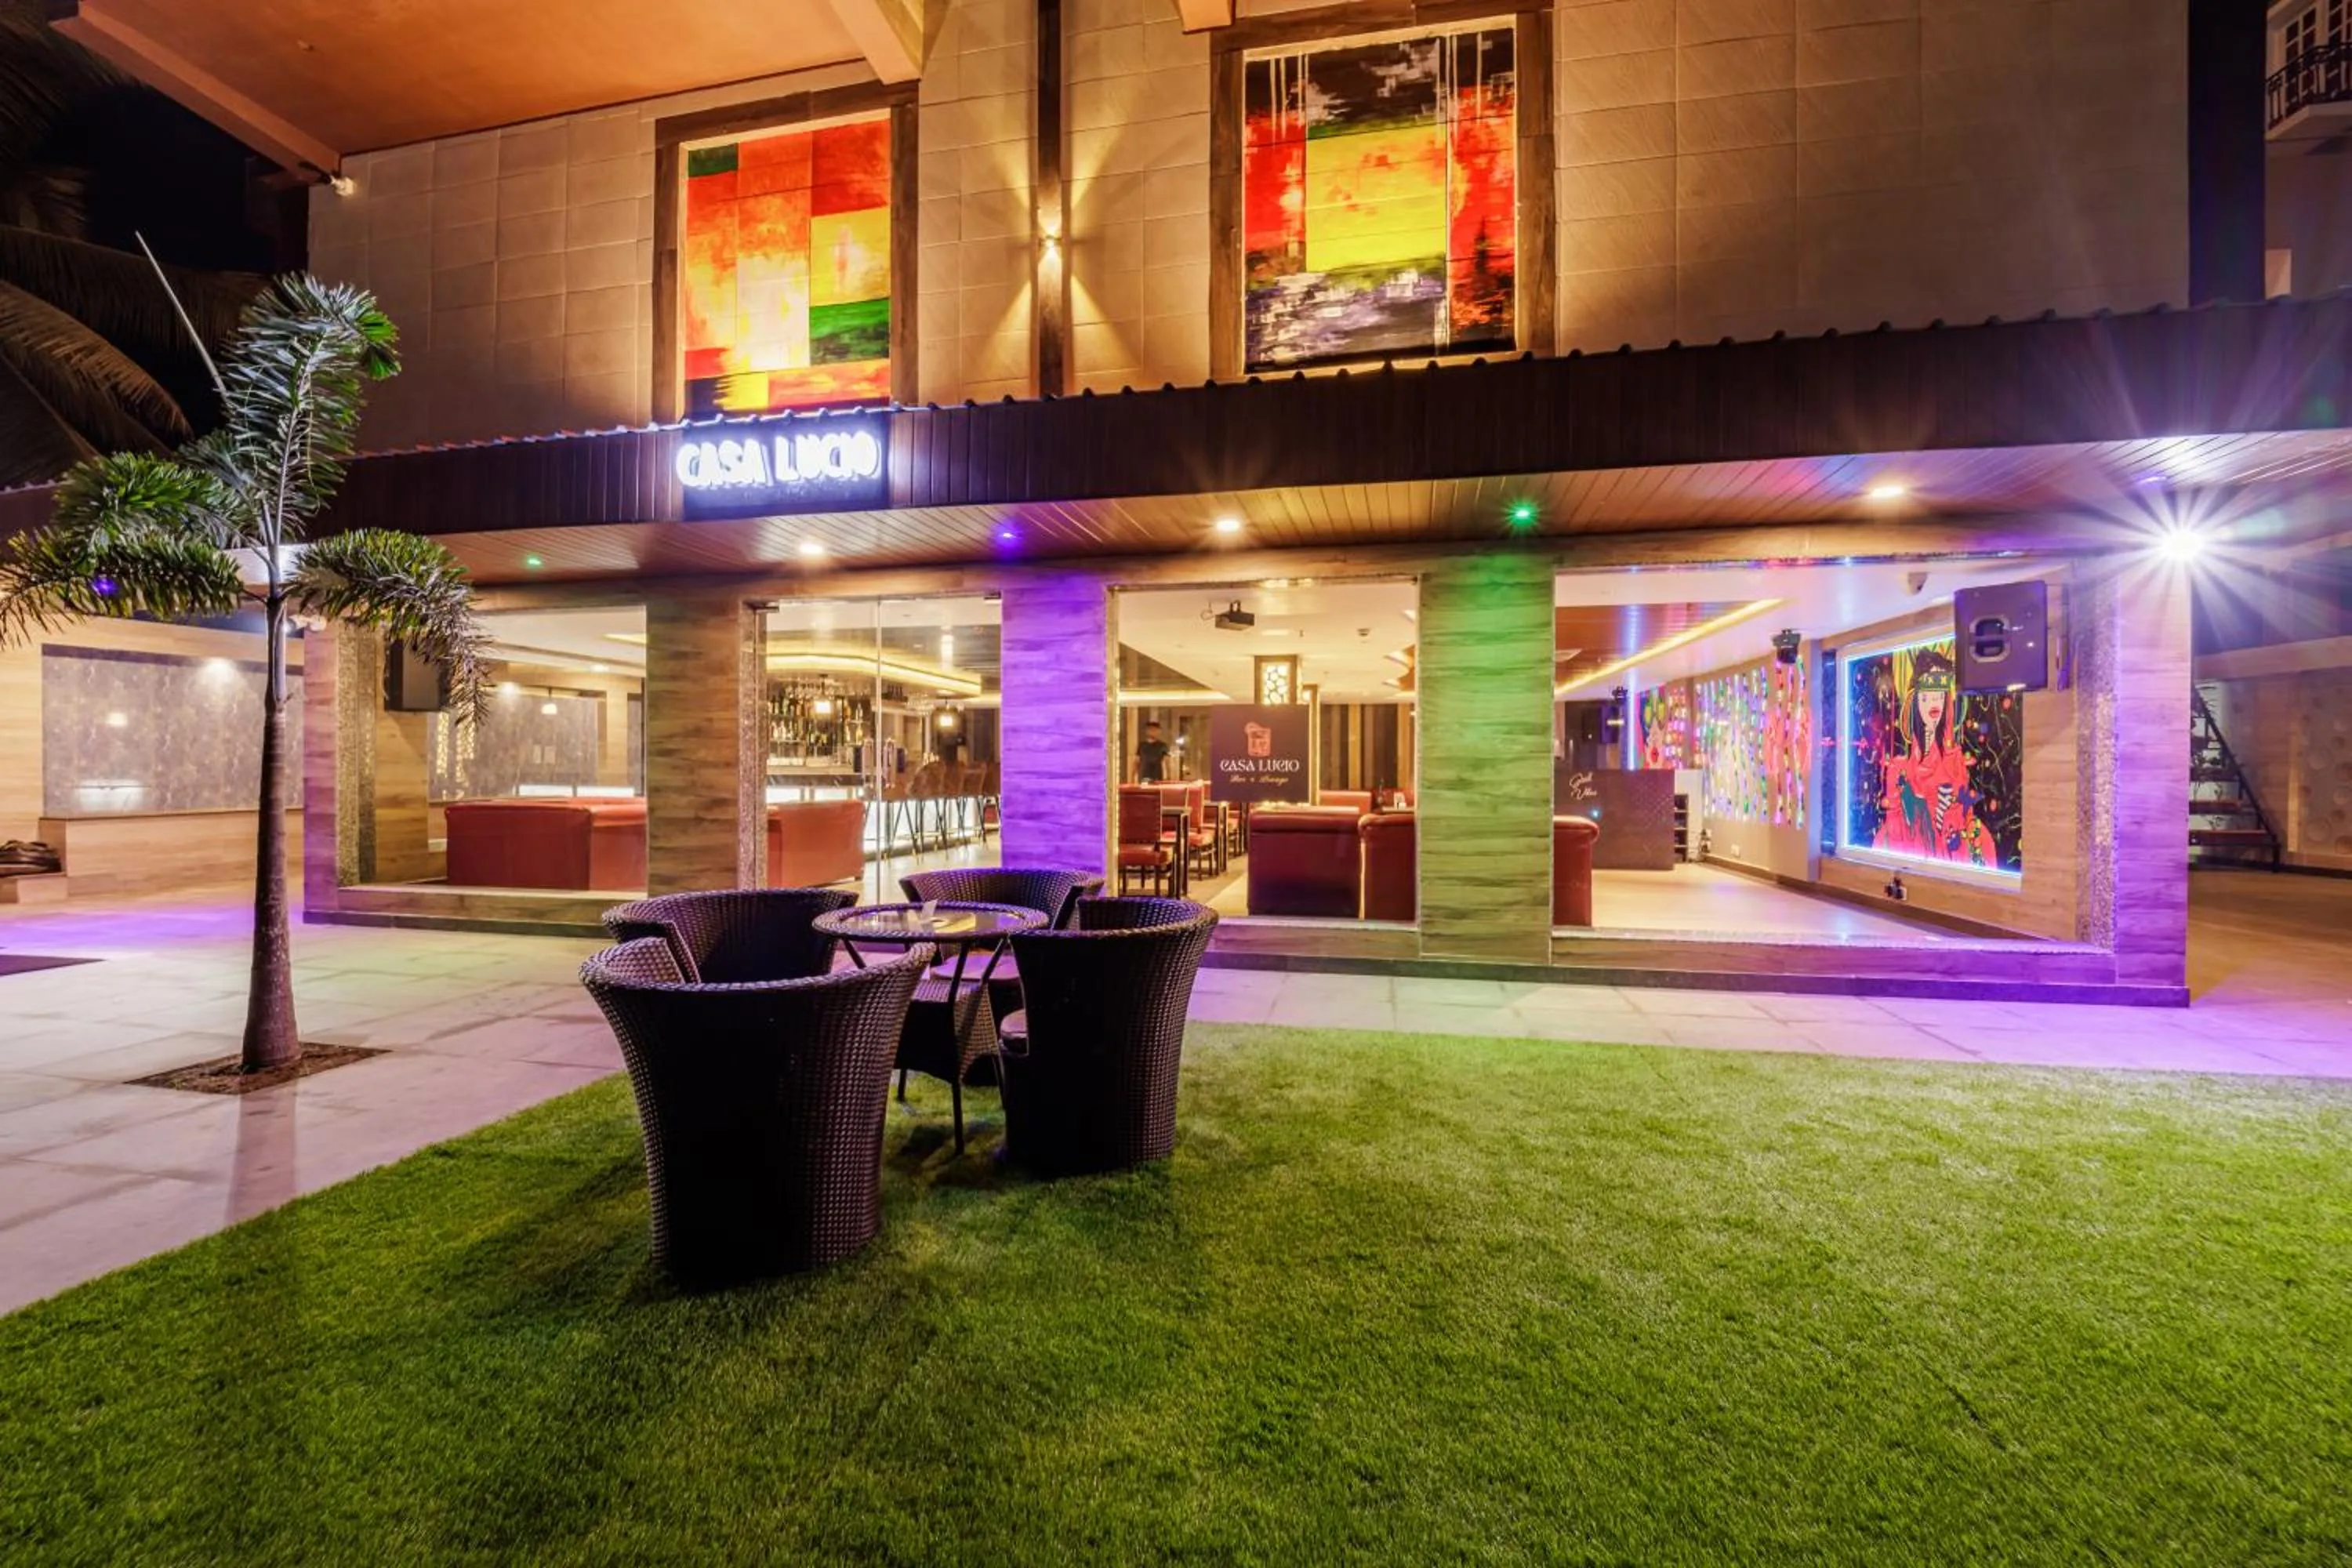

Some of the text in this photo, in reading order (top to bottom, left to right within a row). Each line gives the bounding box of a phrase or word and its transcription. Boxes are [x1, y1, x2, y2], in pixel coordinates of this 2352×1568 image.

[676, 431, 882, 487] CASA LUCIO
[1220, 759, 1300, 772] CASA LUCIO
